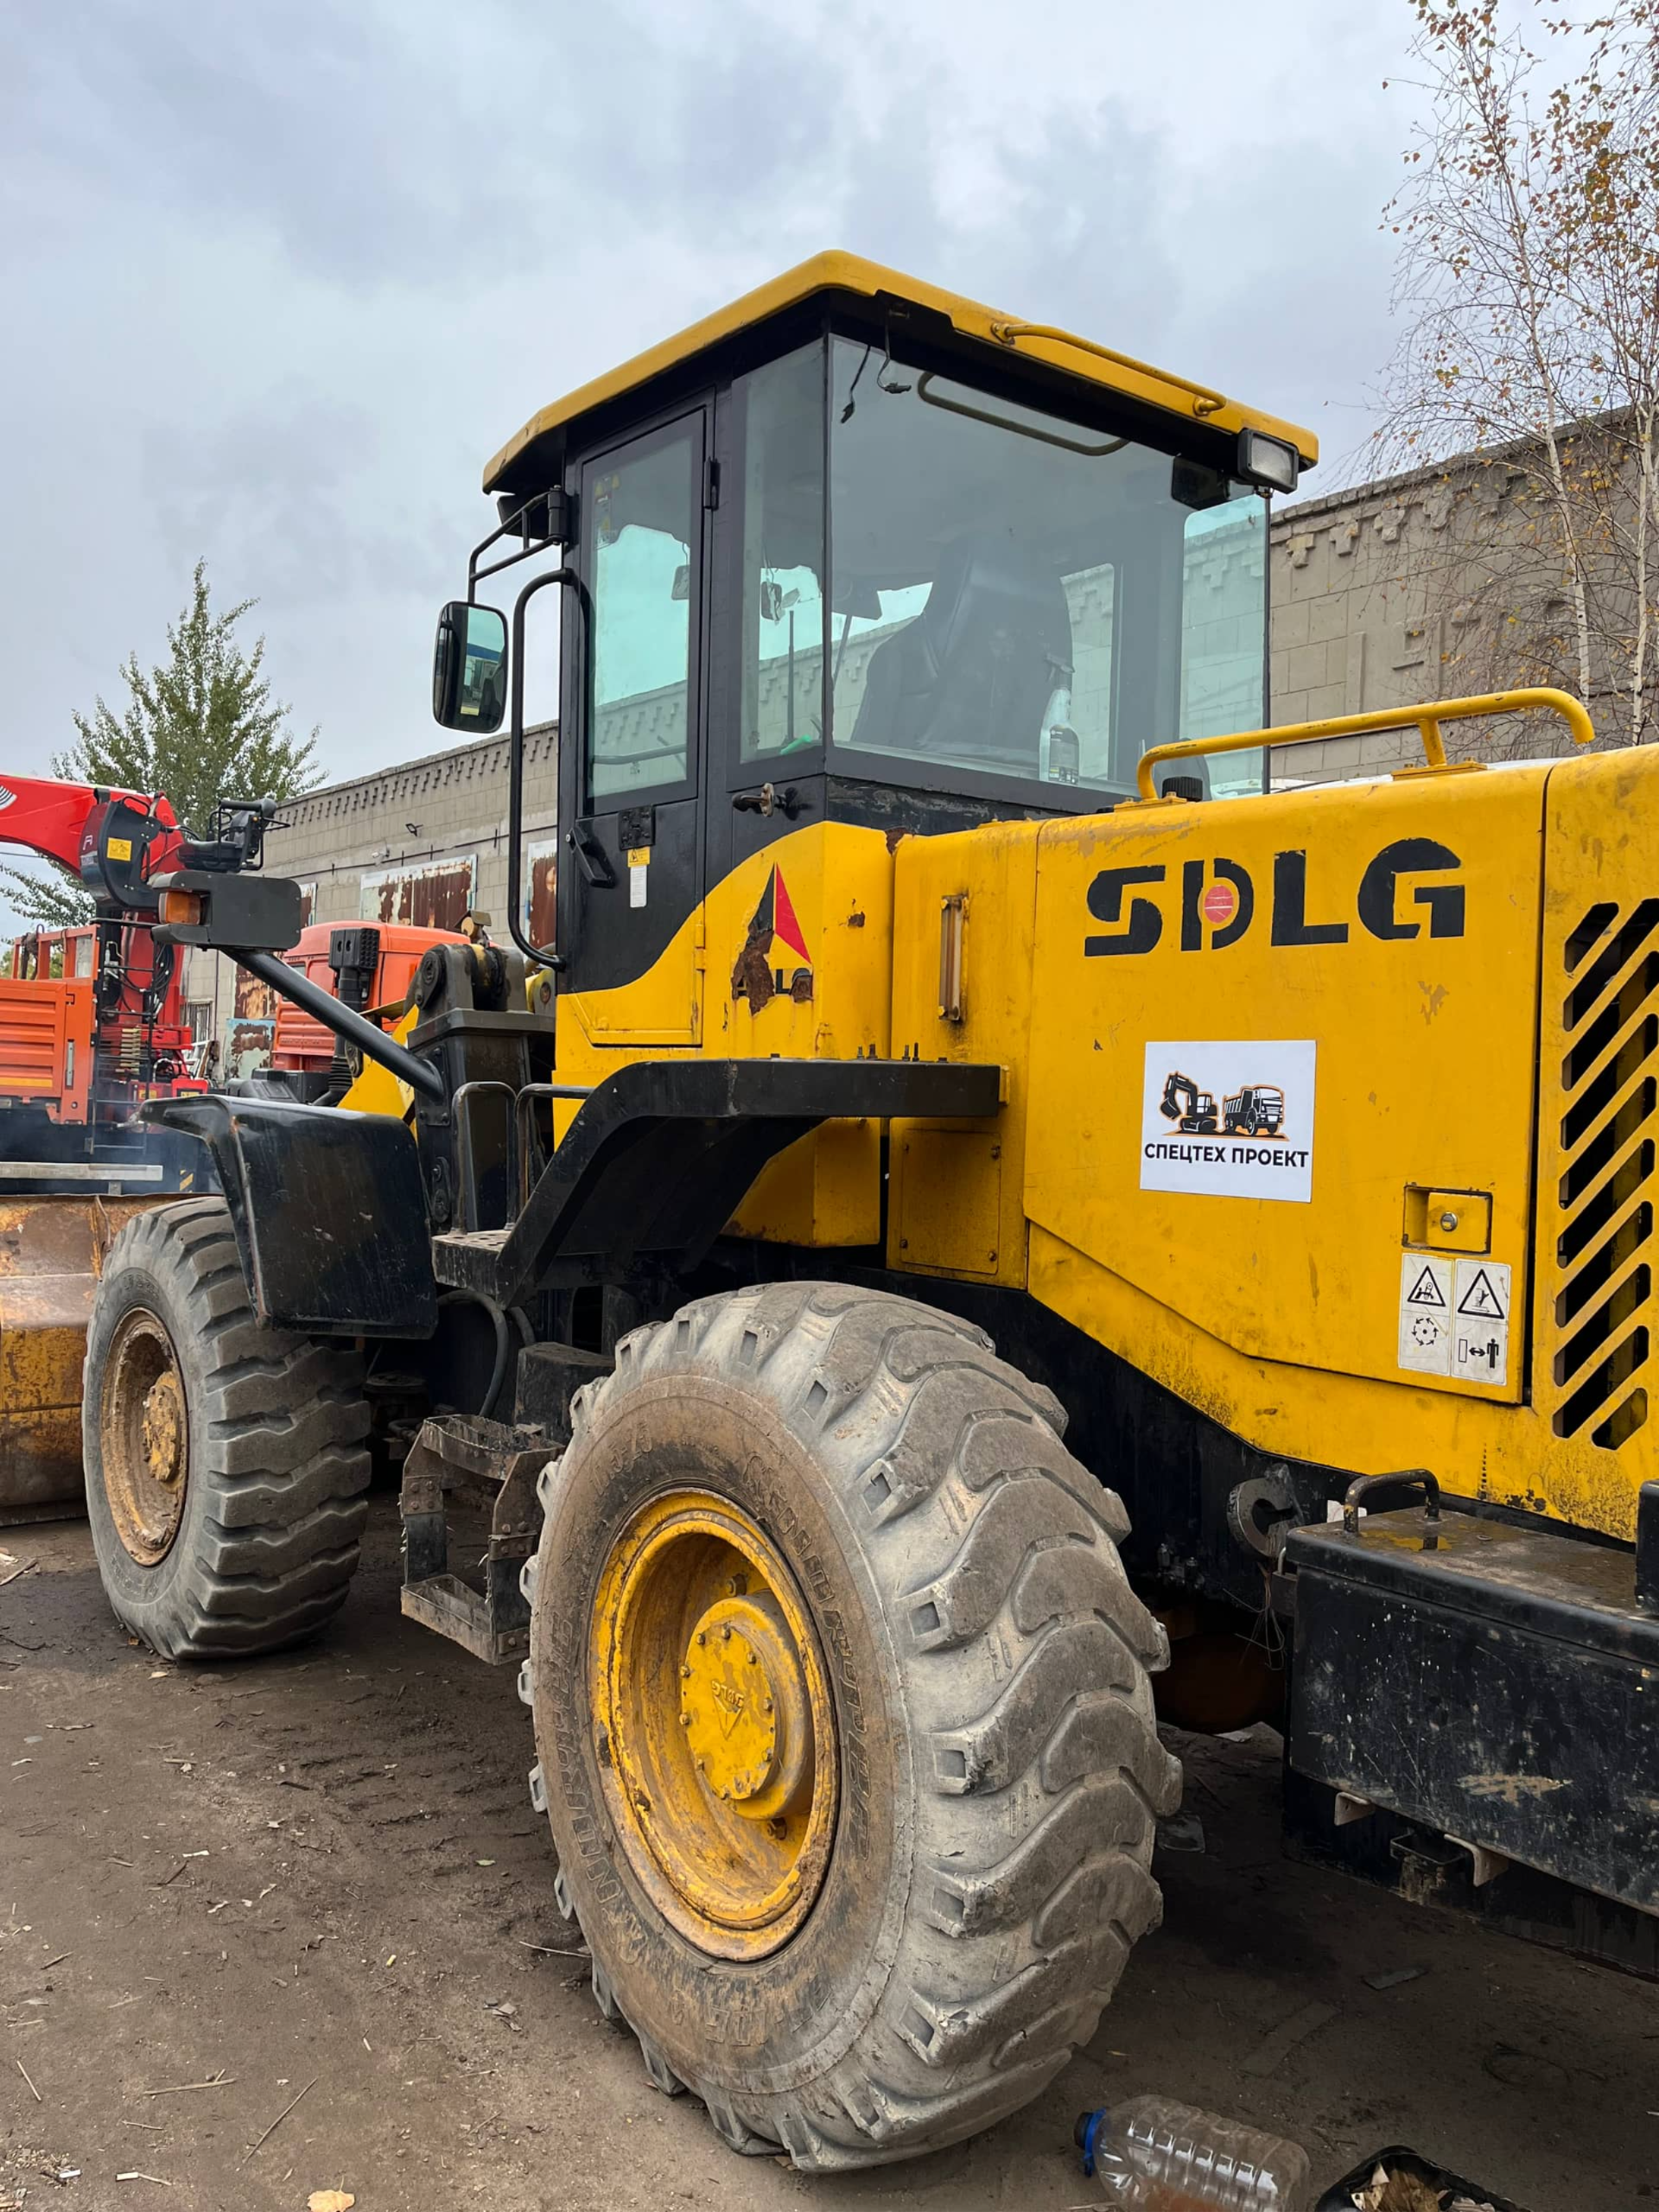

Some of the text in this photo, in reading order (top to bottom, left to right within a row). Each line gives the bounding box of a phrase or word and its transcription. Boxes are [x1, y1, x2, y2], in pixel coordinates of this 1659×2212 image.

[1084, 837, 1465, 957] SDLG
[1144, 1143, 1309, 1167] СПЕЦТЕХ ПРОЕКТ
